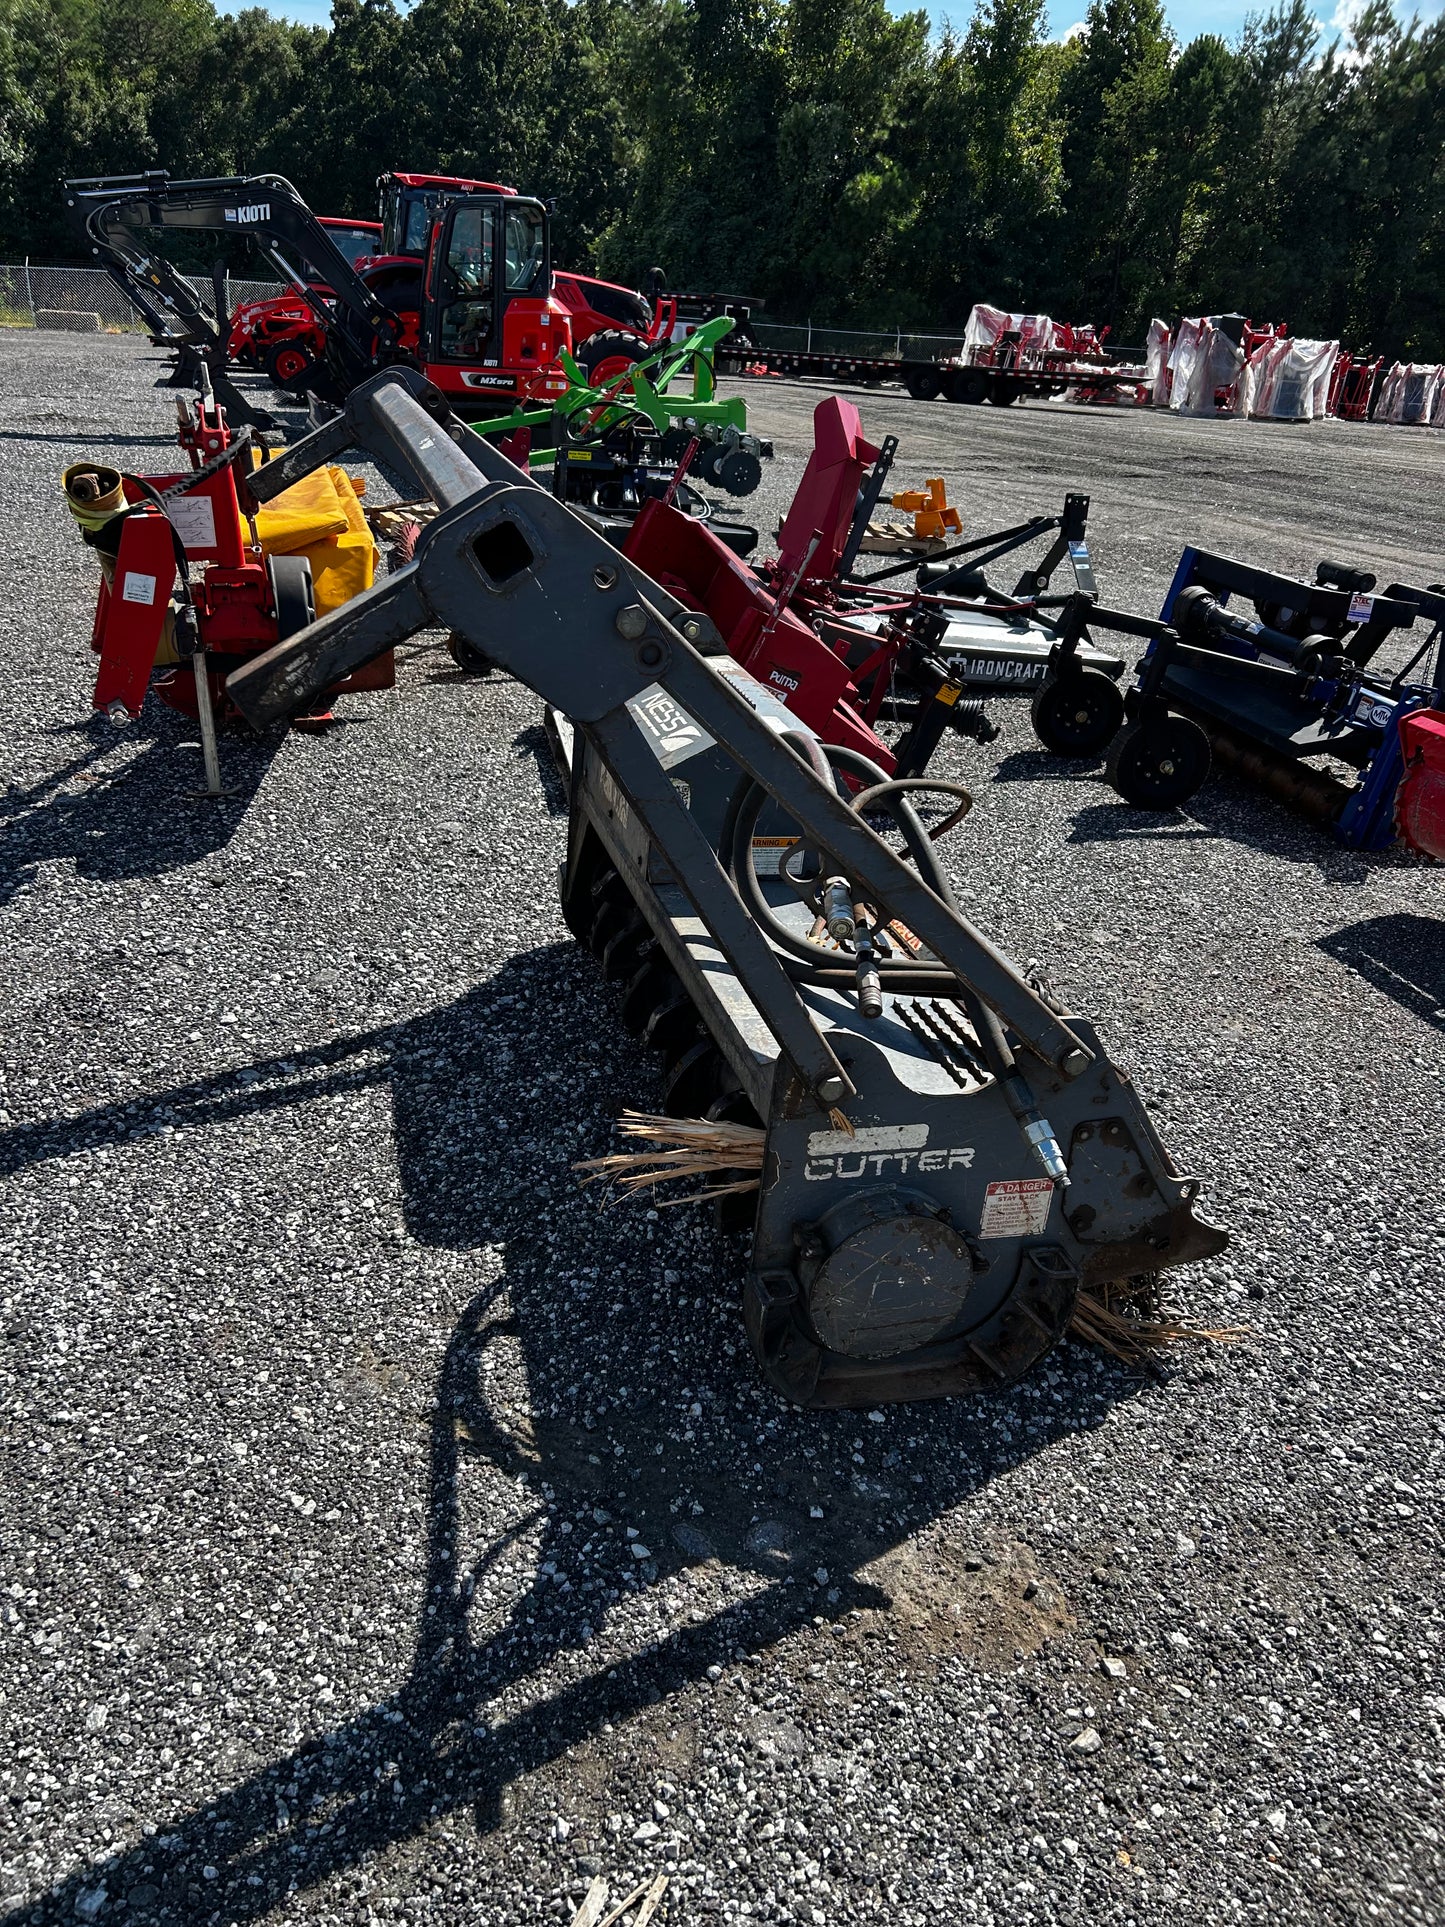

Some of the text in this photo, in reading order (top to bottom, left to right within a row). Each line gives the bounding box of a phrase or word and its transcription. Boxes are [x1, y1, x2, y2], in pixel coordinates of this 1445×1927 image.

[237, 203, 271, 224] KIOTI
[804, 1147, 976, 1181] CUTTER
[1006, 1182, 1047, 1193] DANGER
